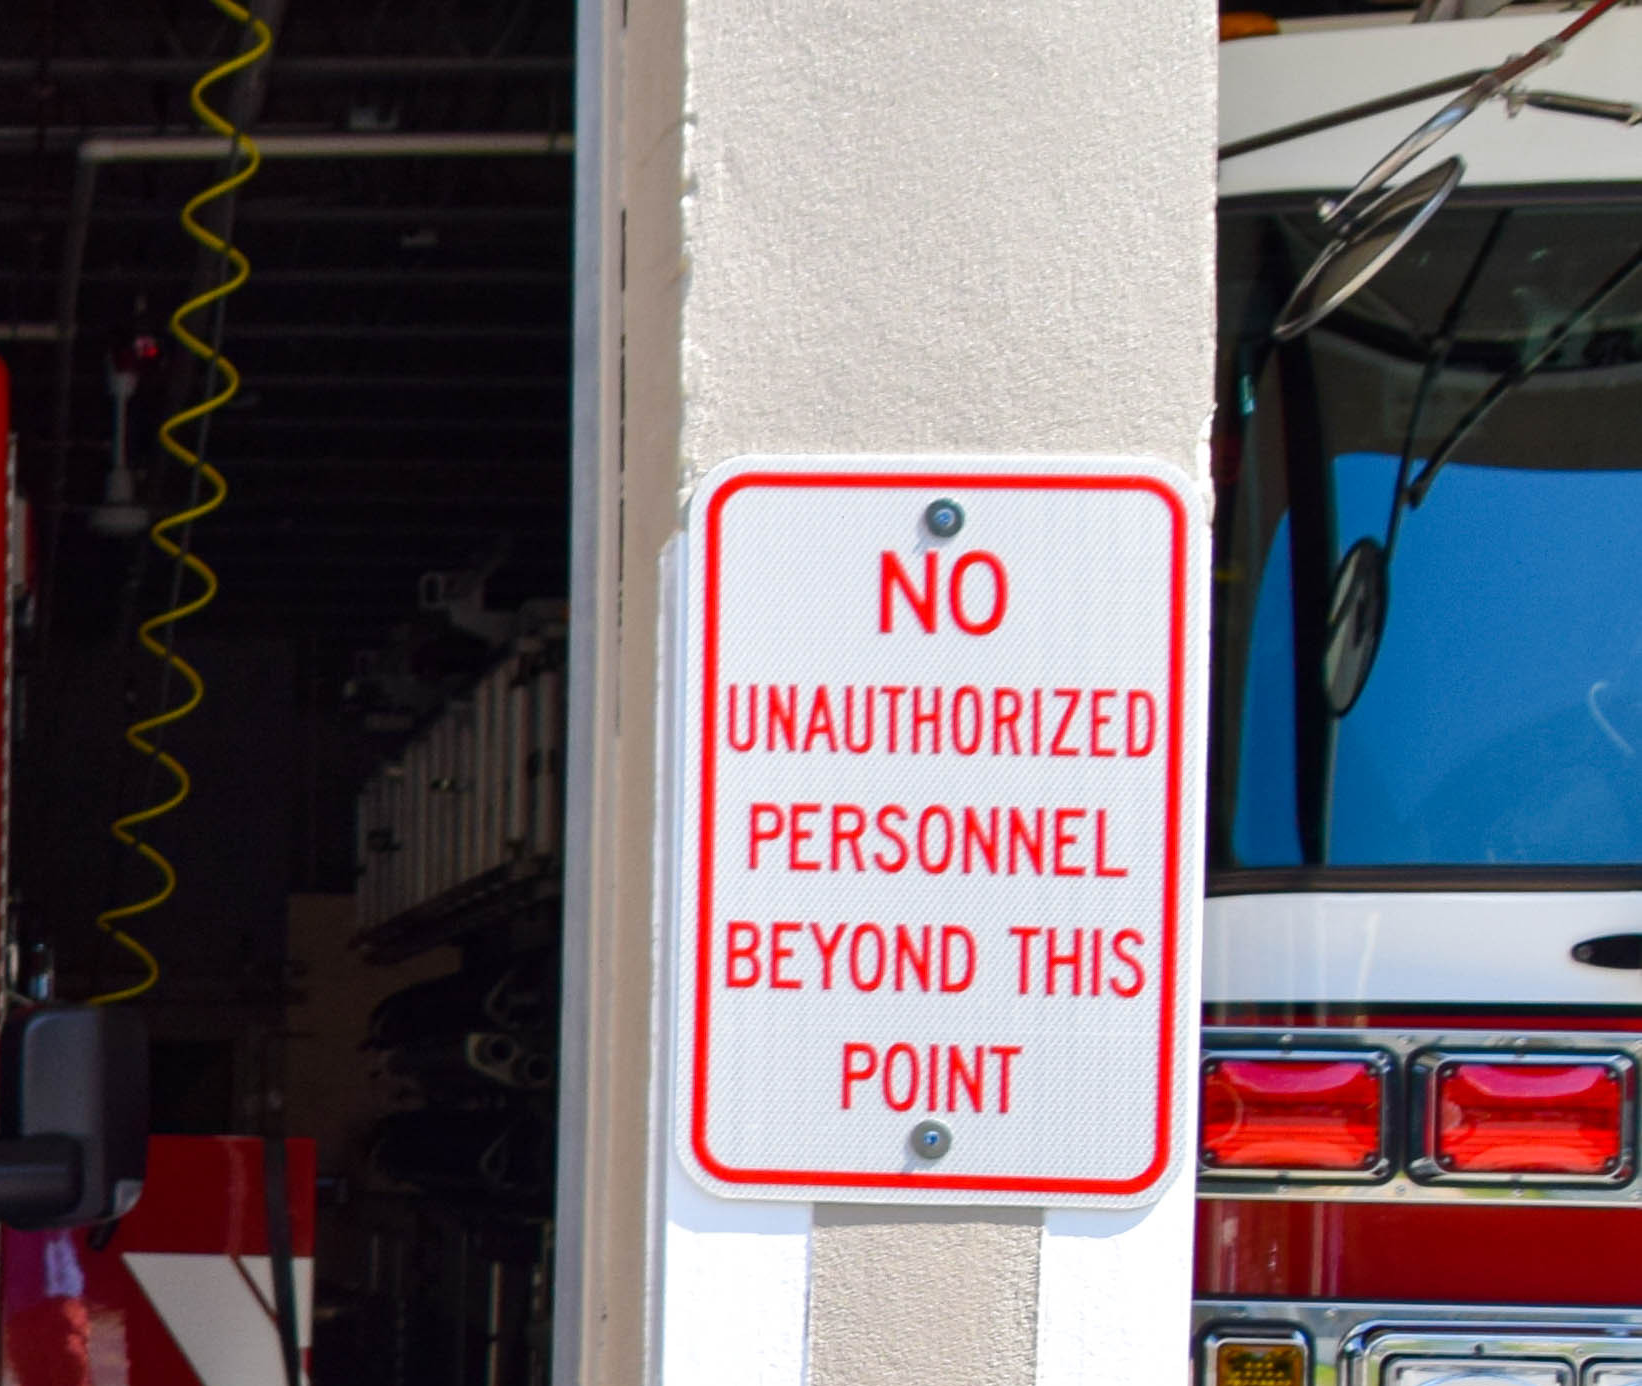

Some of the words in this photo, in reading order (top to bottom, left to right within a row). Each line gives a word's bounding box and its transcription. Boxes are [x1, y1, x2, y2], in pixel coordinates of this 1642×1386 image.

[878, 549, 1009, 635] NO
[727, 683, 1157, 758] UNAUTHORIZED
[748, 803, 1129, 877] PERSONNEL
[724, 921, 977, 993] BEYOND
[1010, 927, 1147, 999] THIS
[841, 1042, 1022, 1114] POINT
